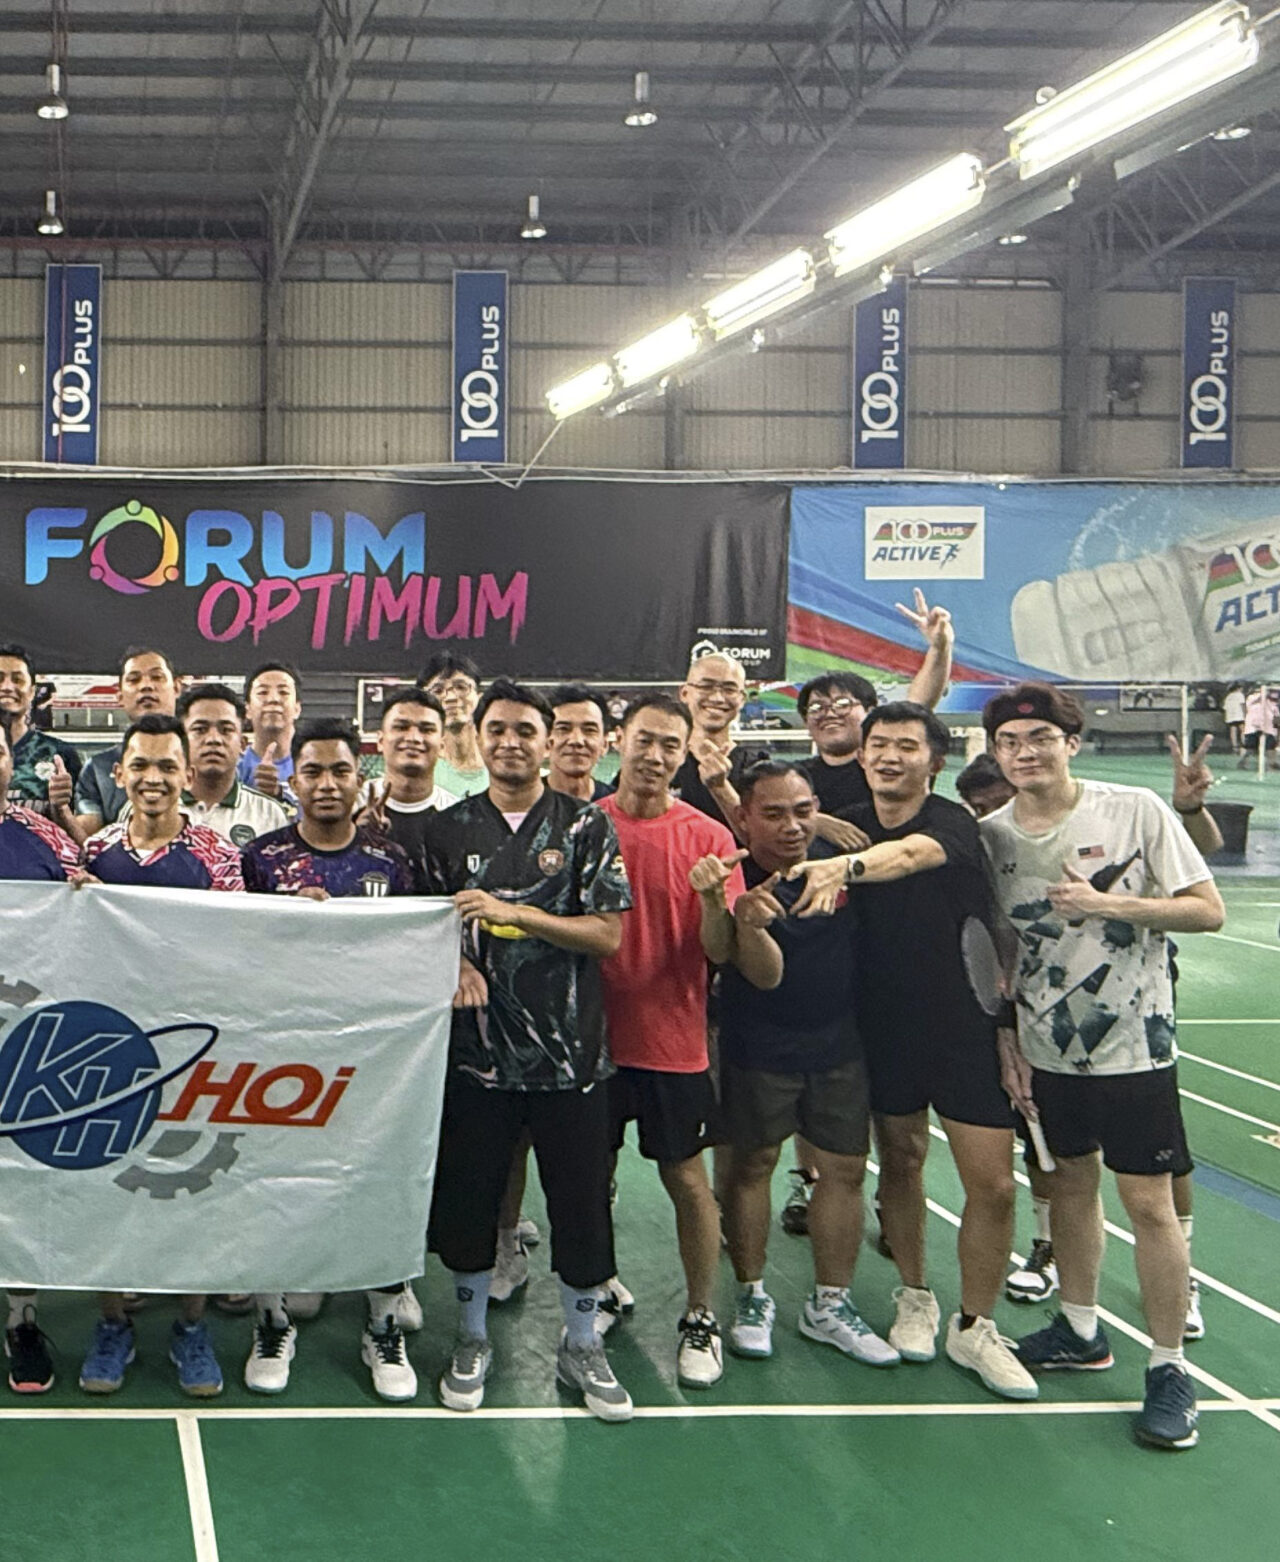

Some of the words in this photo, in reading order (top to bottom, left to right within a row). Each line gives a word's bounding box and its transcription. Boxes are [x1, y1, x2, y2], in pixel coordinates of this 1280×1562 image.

[25, 500, 426, 594] FORUM
[872, 546, 942, 562] ACTIVE
[197, 571, 528, 650] OPTIMUM
